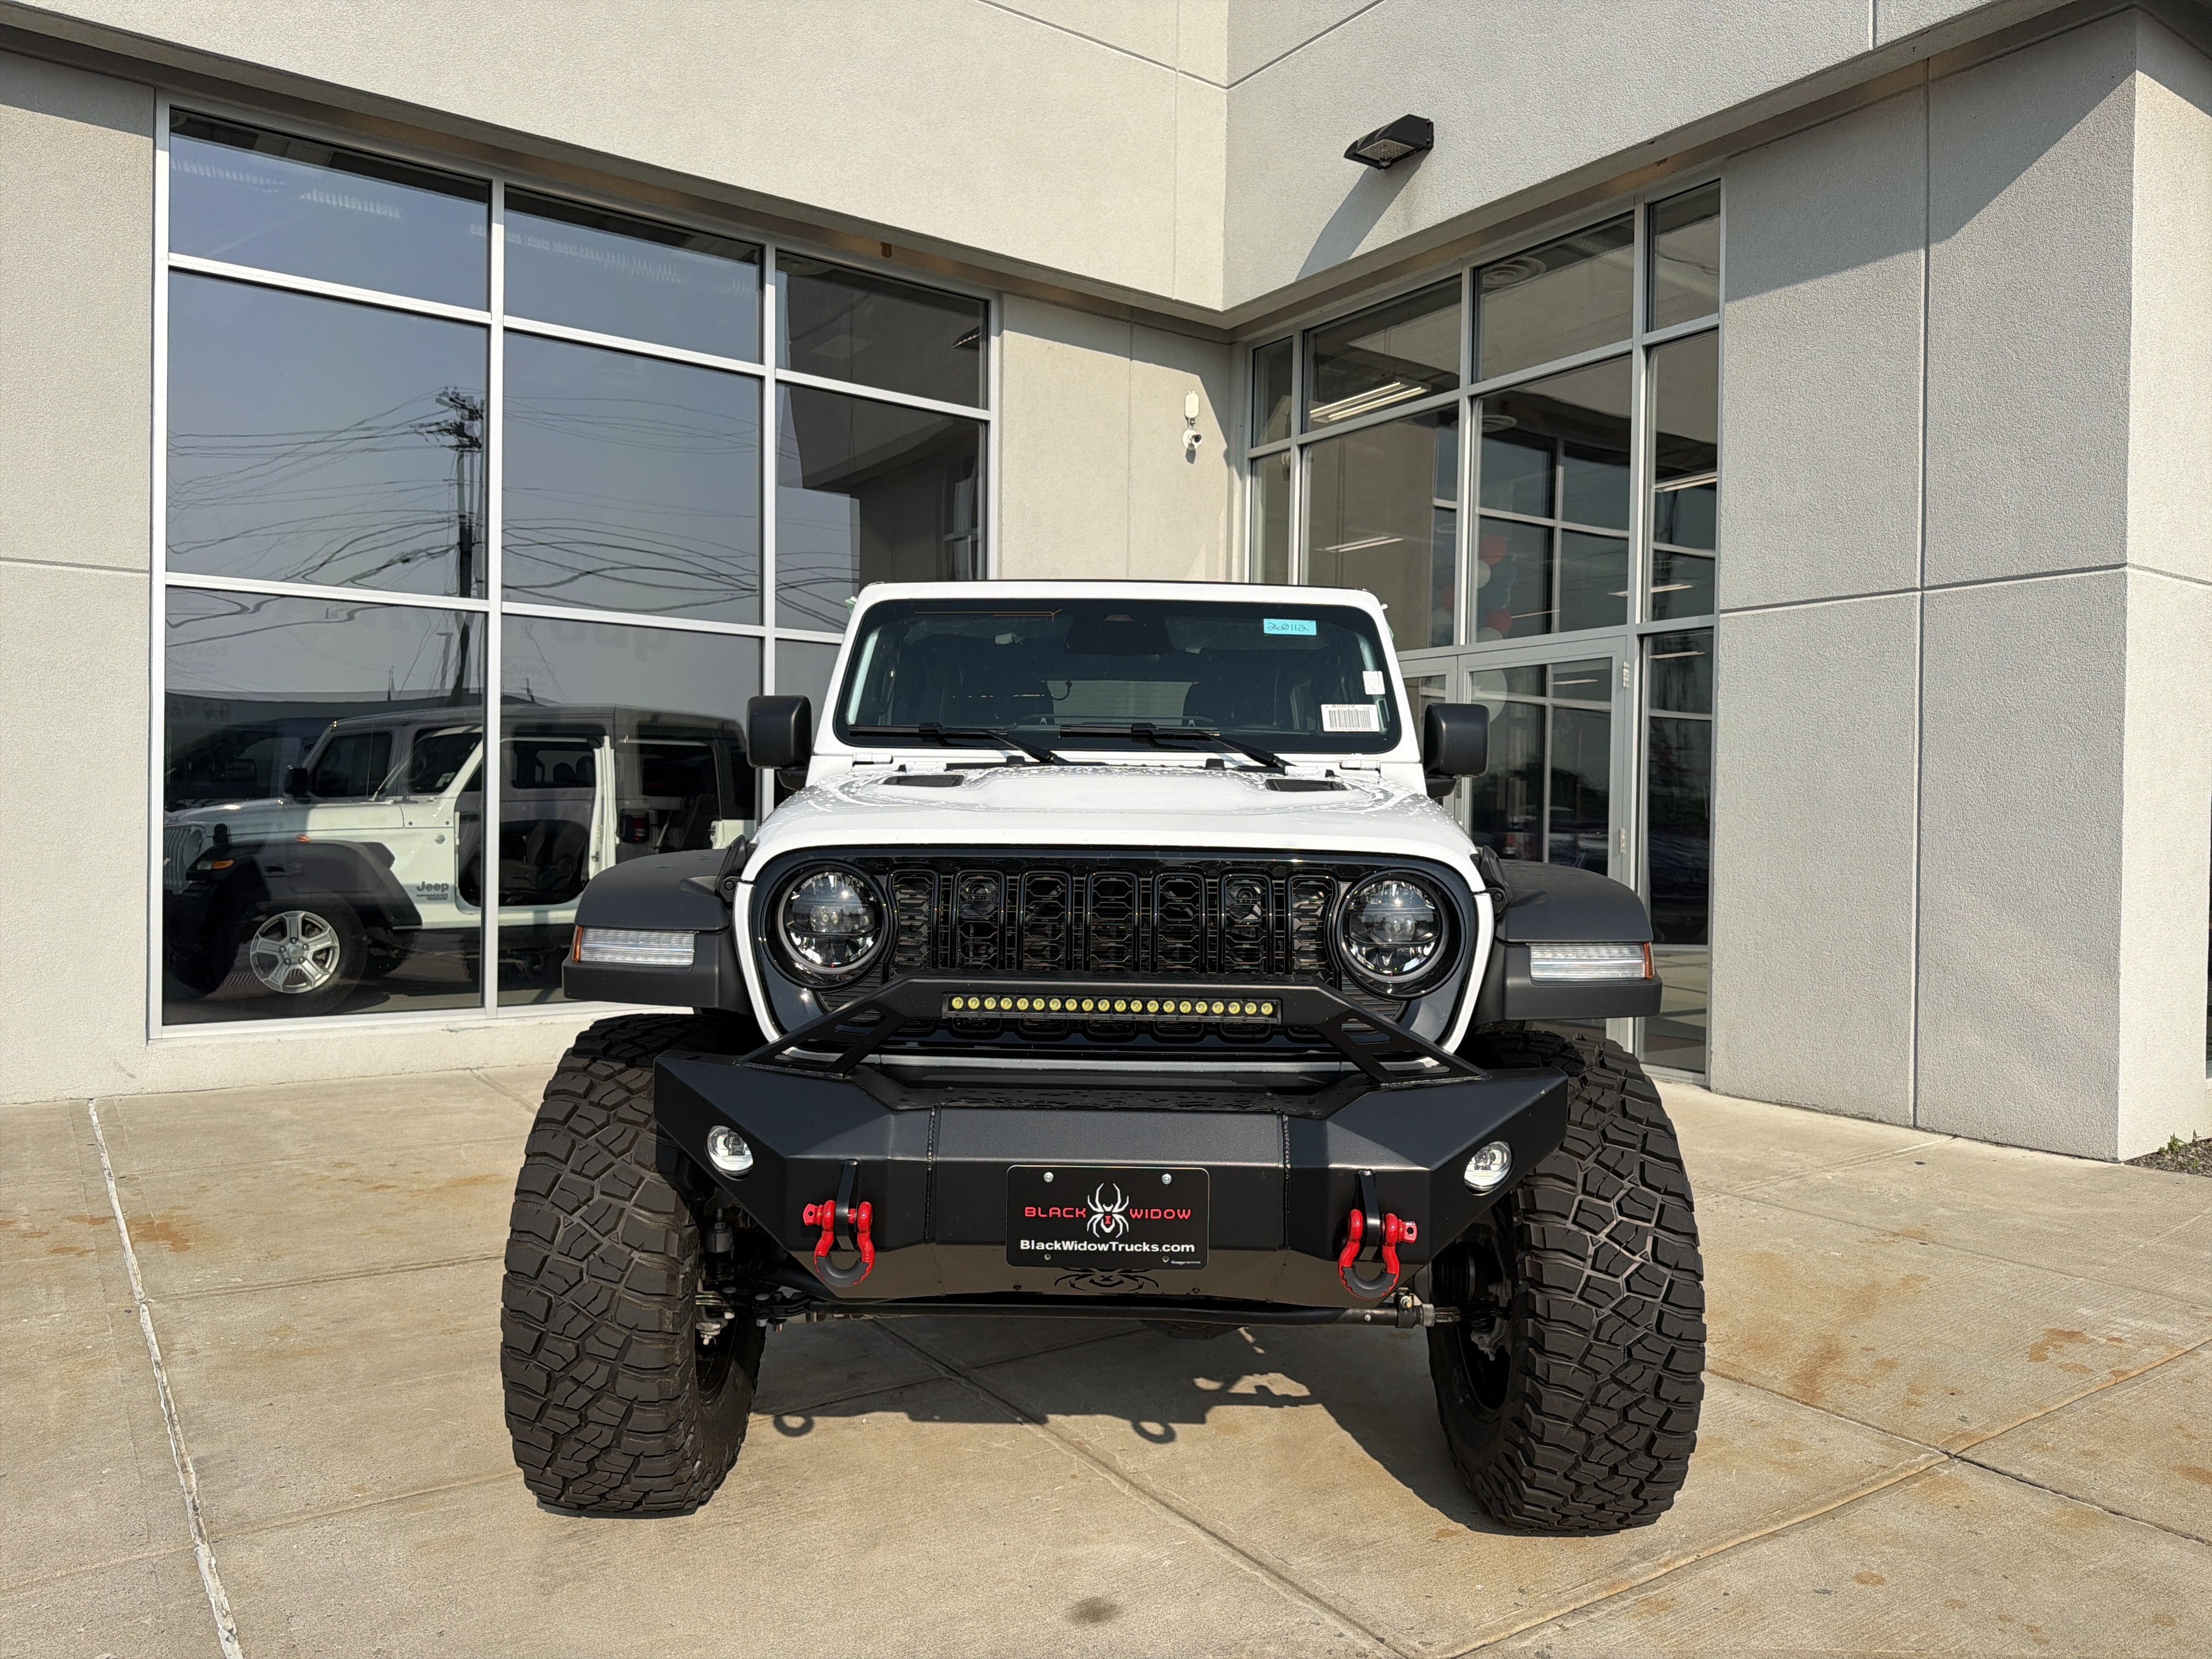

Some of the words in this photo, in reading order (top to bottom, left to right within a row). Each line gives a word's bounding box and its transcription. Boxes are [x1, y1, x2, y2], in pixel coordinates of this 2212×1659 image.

[1268, 622, 1309, 631] 260112
[417, 881, 449, 893] Jeep
[1024, 1206, 1087, 1218] BLACK
[1130, 1209, 1191, 1220] WIDOW
[1020, 1240, 1195, 1252] BlackWidowTrucks.com
